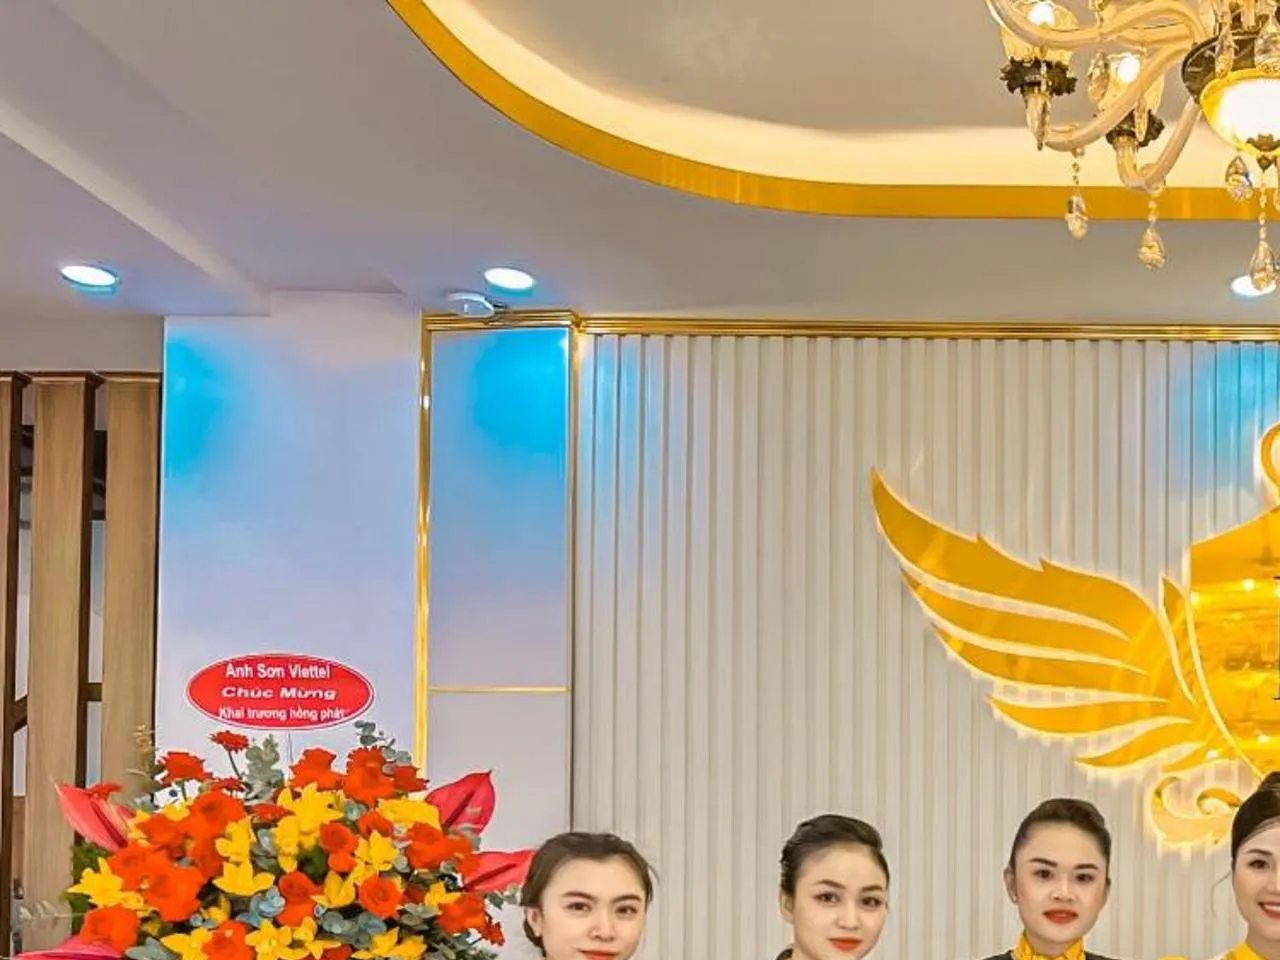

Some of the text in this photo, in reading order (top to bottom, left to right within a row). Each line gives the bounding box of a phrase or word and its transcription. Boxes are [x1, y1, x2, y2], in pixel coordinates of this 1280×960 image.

[226, 663, 330, 679] Anh Sơn Viettel
[222, 687, 336, 700] Chúc Mừng
[219, 706, 245, 719] Khai
[290, 703, 318, 720] hồng
